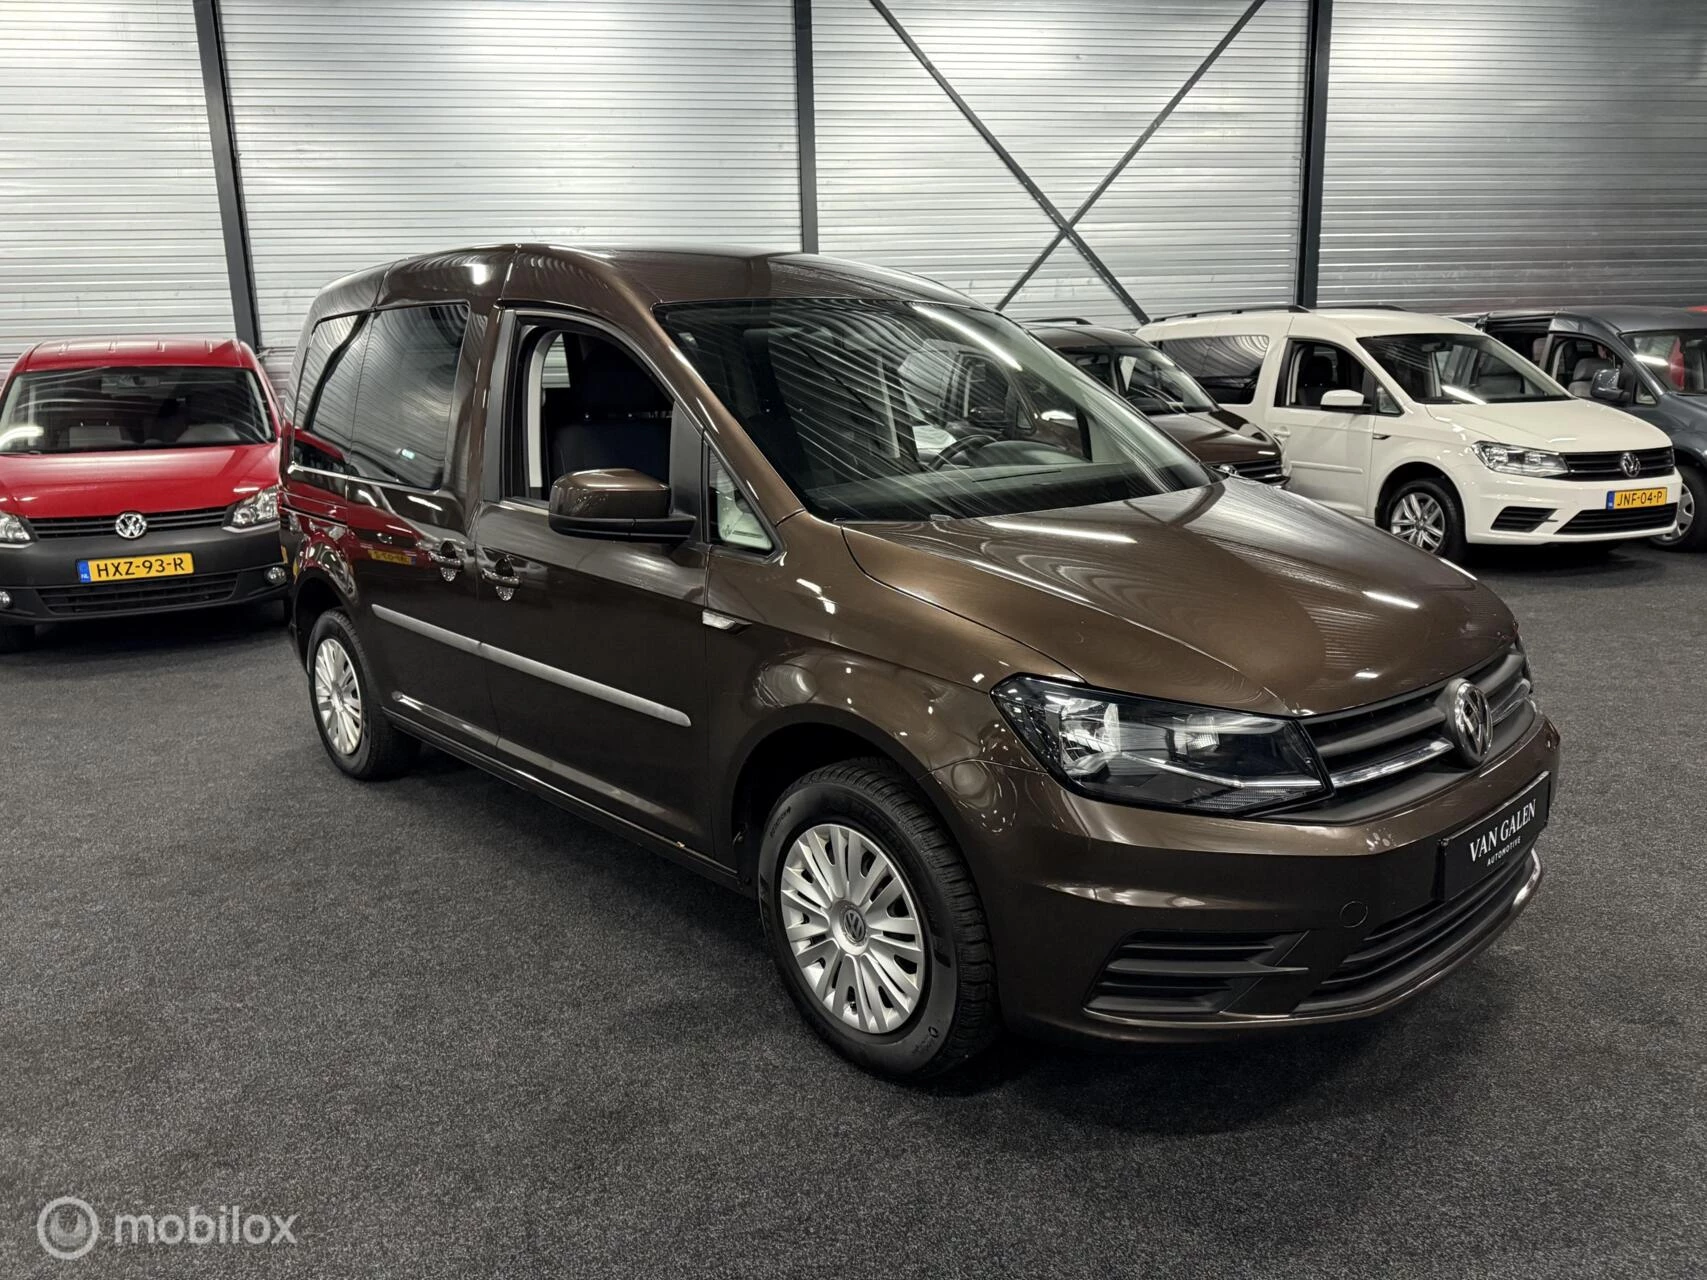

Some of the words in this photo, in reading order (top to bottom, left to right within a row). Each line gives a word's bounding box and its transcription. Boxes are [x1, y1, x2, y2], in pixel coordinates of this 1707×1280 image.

[1616, 490, 1663, 507] JNF-04-P
[96, 556, 185, 578] HXZ-93-R
[1469, 826, 1498, 862] VAN
[1500, 799, 1537, 841] GALEN
[1486, 835, 1521, 867] AUTOMOTIVE
